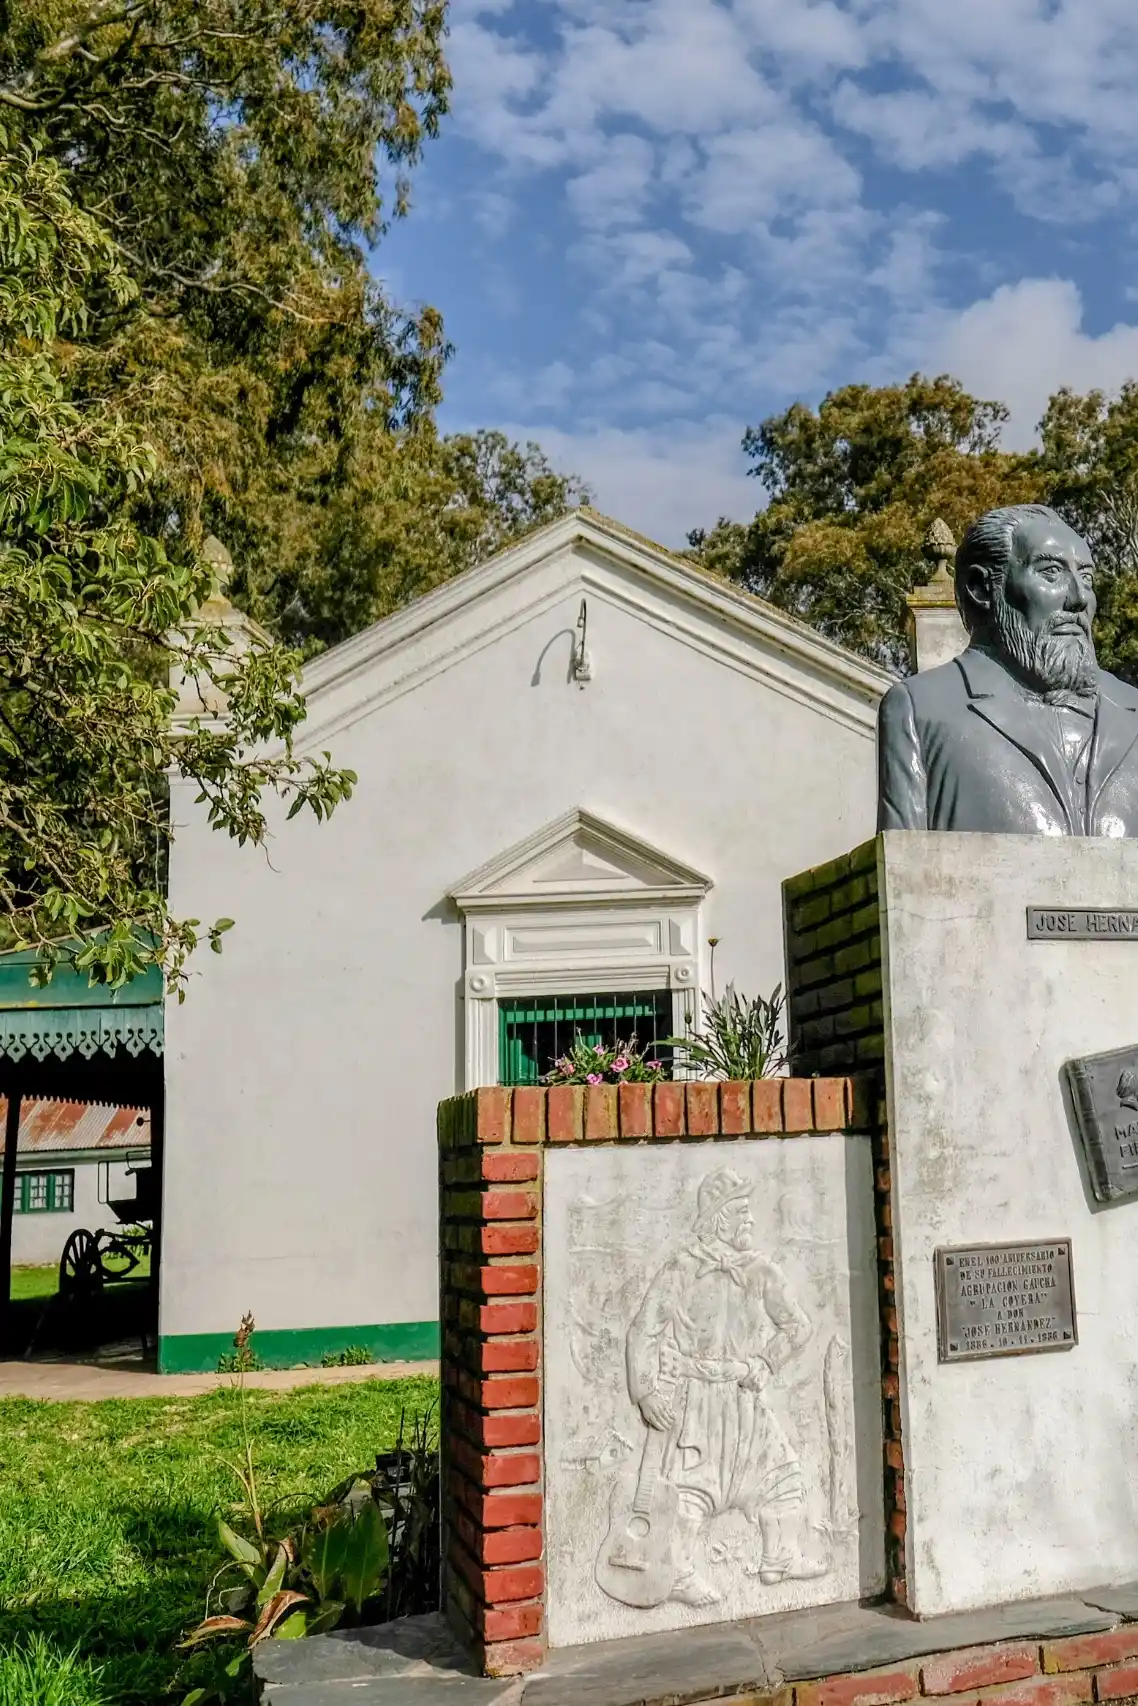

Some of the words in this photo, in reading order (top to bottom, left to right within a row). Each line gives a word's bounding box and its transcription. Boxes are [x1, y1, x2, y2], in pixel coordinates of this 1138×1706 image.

[1036, 913, 1077, 932] JOSE
[960, 1270, 972, 1281] DE
[974, 1269, 986, 1279] SU
[988, 1264, 1053, 1278] FALLECIMIENTO
[961, 1279, 1018, 1297] AGRUPACION
[1023, 1276, 1057, 1290] GAUCHA
